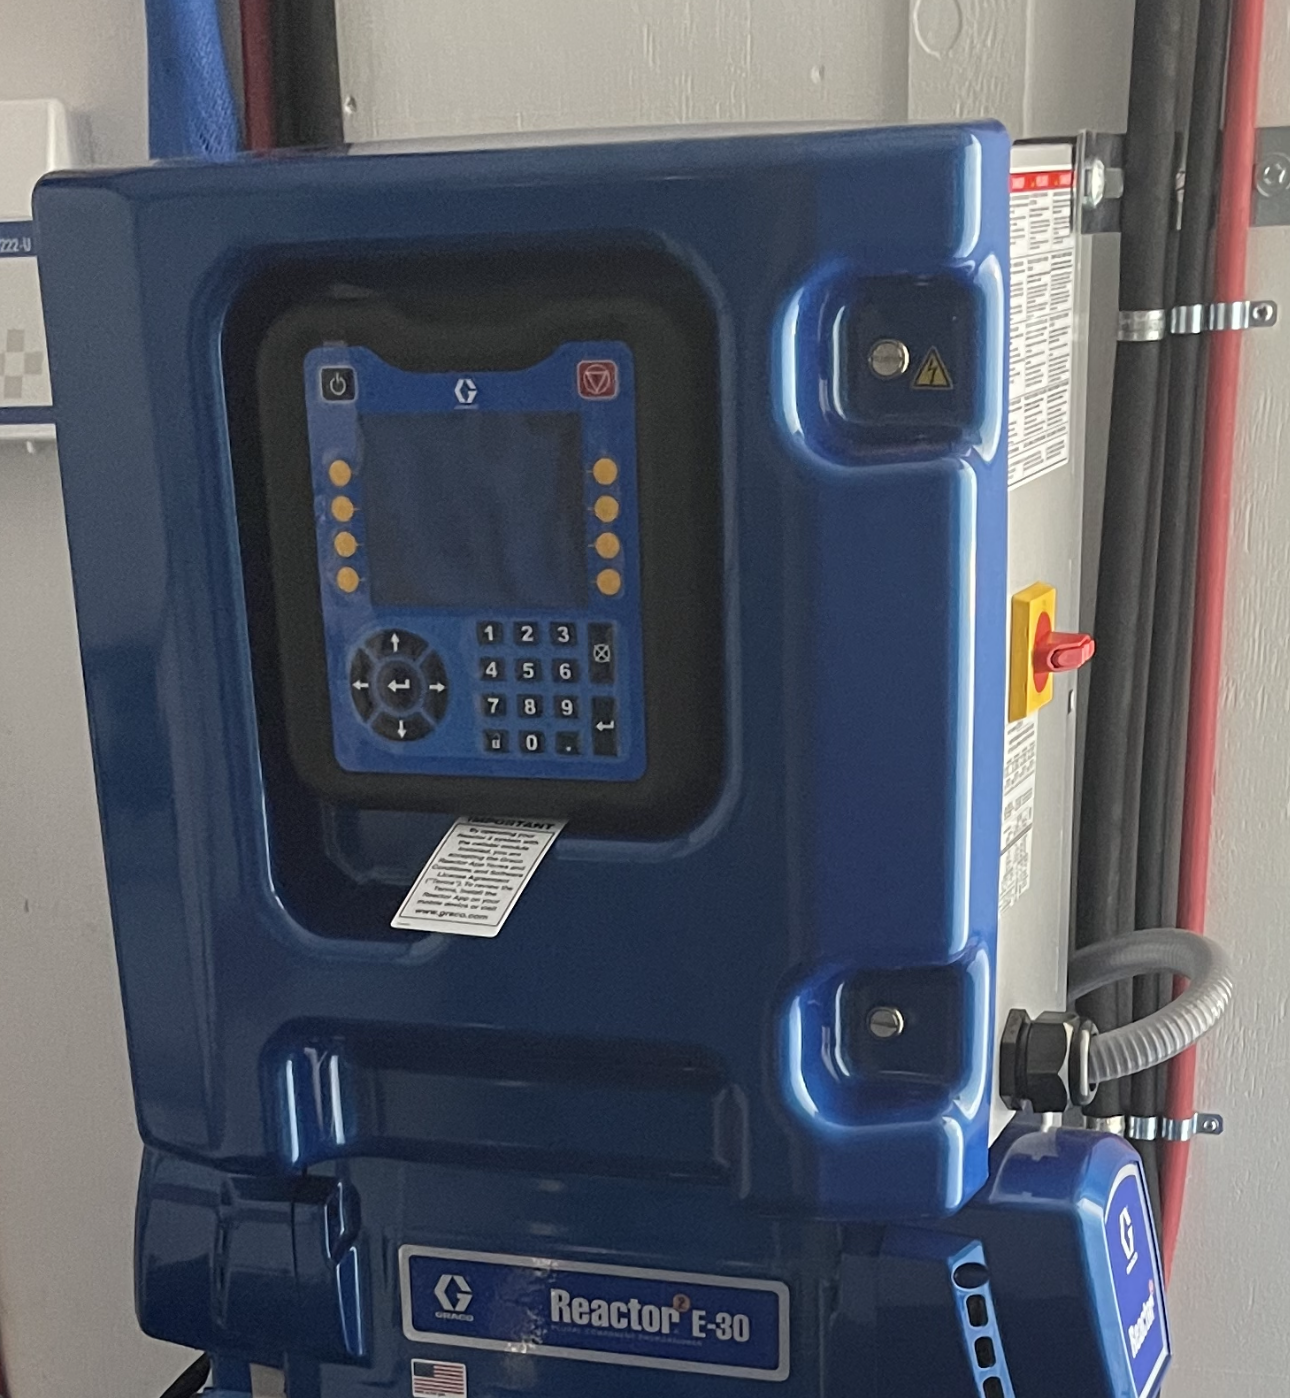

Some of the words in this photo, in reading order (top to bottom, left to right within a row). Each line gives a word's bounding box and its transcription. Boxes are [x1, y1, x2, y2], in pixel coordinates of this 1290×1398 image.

[484, 625, 494, 641] 1
[521, 626, 534, 642] 2
[557, 626, 570, 642] 3
[485, 661, 498, 677] 4
[523, 662, 534, 679] 5
[559, 663, 572, 679] 6
[487, 698, 499, 713] 7
[524, 698, 536, 715] 8
[561, 699, 573, 715] 9
[525, 735, 538, 751] 0
[467, 816, 555, 830] IMPORTANT
[414, 908, 489, 920] www.graco.com
[434, 1311, 475, 1322] GRACO
[550, 1287, 680, 1334] Reactor
[691, 1309, 750, 1342] E-30
